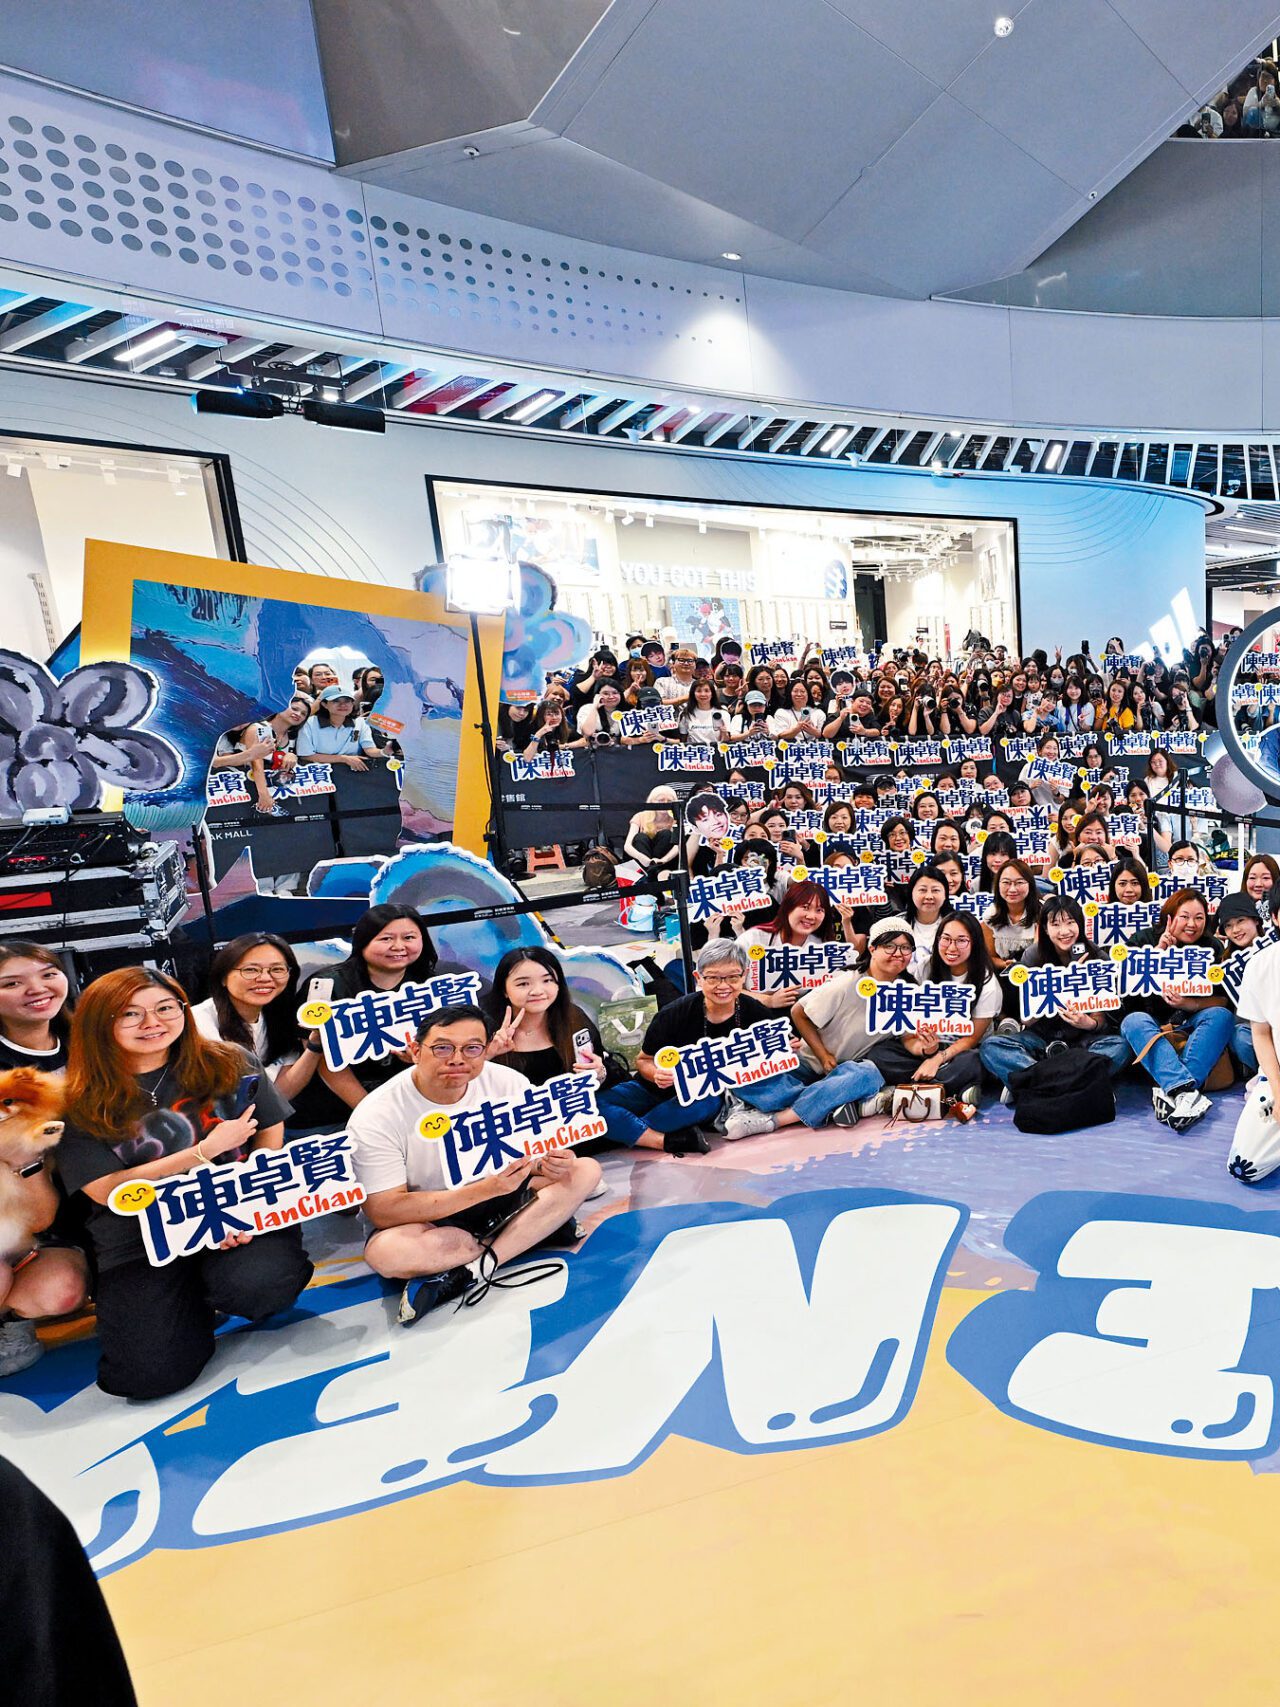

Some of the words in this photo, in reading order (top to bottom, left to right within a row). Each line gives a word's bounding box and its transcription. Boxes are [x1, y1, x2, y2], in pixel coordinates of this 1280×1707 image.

[620, 560, 664, 585] YOU
[670, 566, 708, 588] GOT
[718, 569, 757, 592] THIS
[750, 641, 795, 665] 陳卓賢
[821, 646, 856, 667] 陳卓賢
[1242, 653, 1280, 673] 陳卓賢
[1232, 684, 1257, 699] 卓賢
[620, 707, 674, 736] 陳卓賢
[784, 742, 833, 763] 陳卓賢
[843, 741, 892, 766] 陳卓賢
[894, 741, 944, 766] 陳卓賢
[947, 738, 992, 762] 陳卓賢
[1005, 738, 1040, 761] 陳卓
[1057, 734, 1098, 758] 陳卓賢
[1109, 732, 1150, 756] 陳卓賢
[1155, 732, 1197, 753] 陳卓賢
[512, 751, 573, 780] 陳卓賢
[660, 745, 714, 769] 陳卓賢
[726, 742, 776, 768] 陳卓賢
[771, 761, 827, 788] 陳卓賢
[1028, 757, 1076, 782] 陳卓賢
[208, 773, 245, 796] 卓賢
[296, 784, 336, 796] IanChan
[801, 780, 827, 788] nChan
[210, 794, 250, 806] anChan
[878, 795, 911, 811] 卓賢
[977, 789, 1010, 807] 陳卓
[788, 811, 823, 830] 卓賢
[1107, 815, 1139, 836] 卓賢
[210, 831, 223, 842] AK
[225, 829, 253, 839] MALL
[1015, 832, 1050, 855] 卓賢
[1110, 836, 1141, 846] anChan
[873, 850, 918, 883] 陳卓
[1019, 854, 1051, 864] anChan
[688, 868, 766, 920] 陳卓賢
[808, 866, 886, 904] 陳卓賢
[1060, 864, 1114, 905] 陳卓
[721, 896, 772, 915] IanChan
[842, 894, 887, 905] IanChan
[952, 895, 995, 920] 卓賢
[751, 960, 759, 991] Australia
[759, 944, 852, 992] 陳卓賢
[1121, 947, 1214, 995] 陳卓賢
[1023, 961, 1117, 1018] 陳卓賢
[1161, 983, 1212, 996] IanChan
[869, 984, 973, 1032] 陳卓賢
[324, 975, 479, 1068] 陳卓賢
[674, 1020, 789, 1103] 陳卓賢
[735, 1055, 798, 1085] IanChan
[444, 1075, 600, 1183] 陳卓賢
[523, 1119, 606, 1158] IanChan
[142, 1138, 351, 1262] 陳卓賢
[254, 1185, 365, 1231] IanChan
